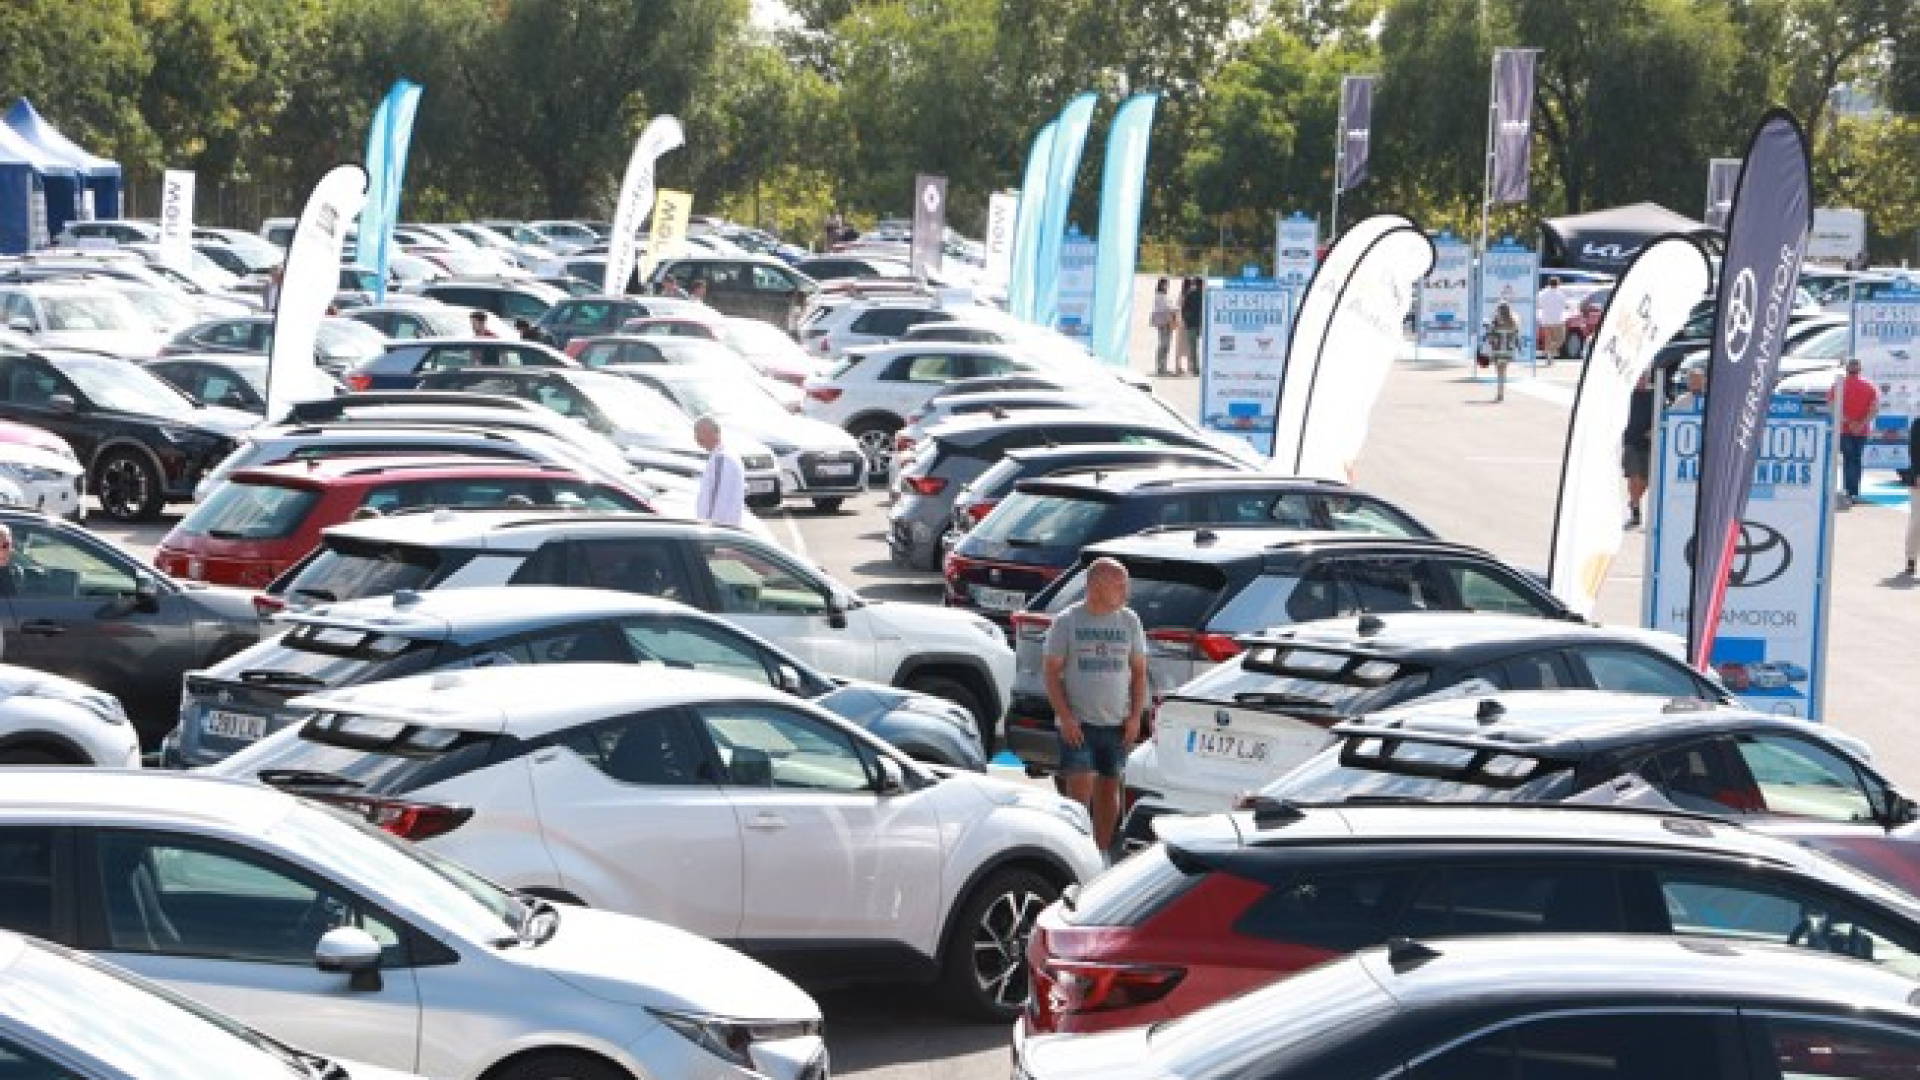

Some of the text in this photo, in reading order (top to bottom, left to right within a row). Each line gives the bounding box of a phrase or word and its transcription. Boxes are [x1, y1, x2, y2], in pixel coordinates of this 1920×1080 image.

[164, 181, 181, 236] new
[655, 199, 678, 250] new
[992, 204, 1005, 253] new
[1736, 243, 1793, 449] HERSAMOTOR
[1675, 420, 1817, 463] OION
[1676, 458, 1812, 486] ALNDAS
[1671, 604, 1797, 627] HAMOTOR
[1200, 732, 1237, 757] 1417
